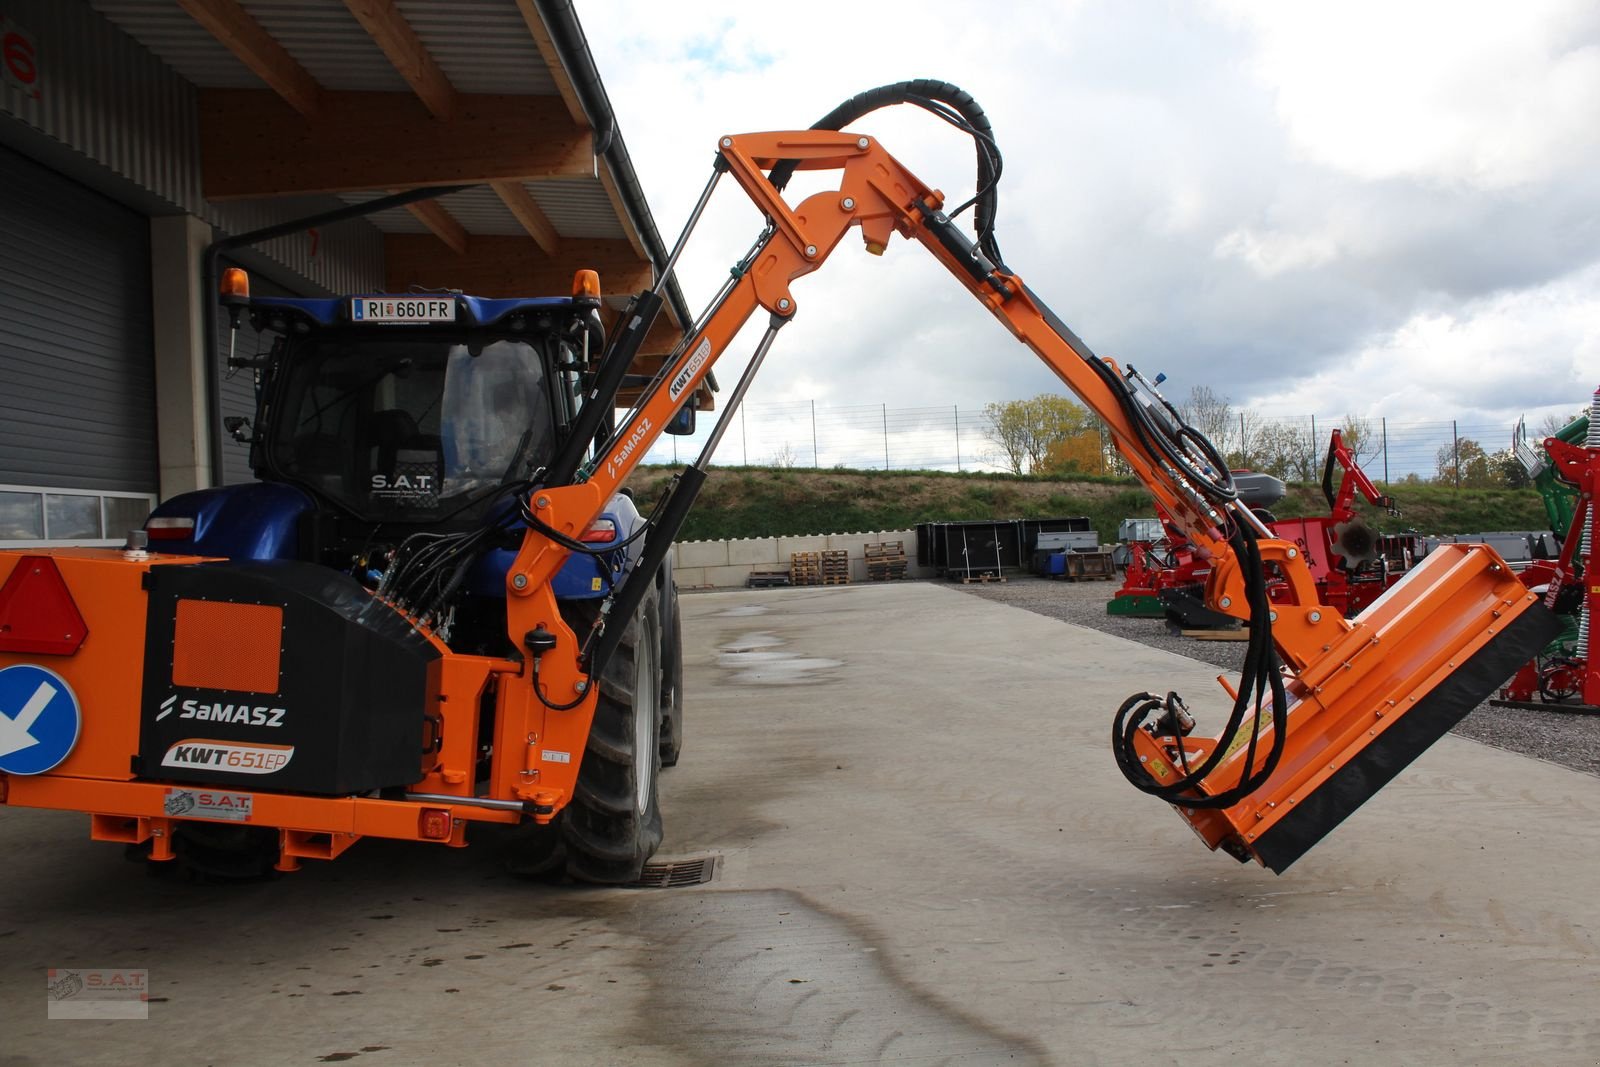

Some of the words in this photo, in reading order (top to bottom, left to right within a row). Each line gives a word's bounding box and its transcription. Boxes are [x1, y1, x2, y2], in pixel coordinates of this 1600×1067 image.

[3, 32, 36, 84] 6
[369, 302, 383, 317] RI
[397, 302, 425, 317] 660
[429, 302, 448, 317] FR
[613, 417, 653, 468] SaMASZ
[371, 474, 431, 489] S.A.T.
[179, 699, 286, 728] SaMASZ
[197, 793, 250, 809] S.A.T.
